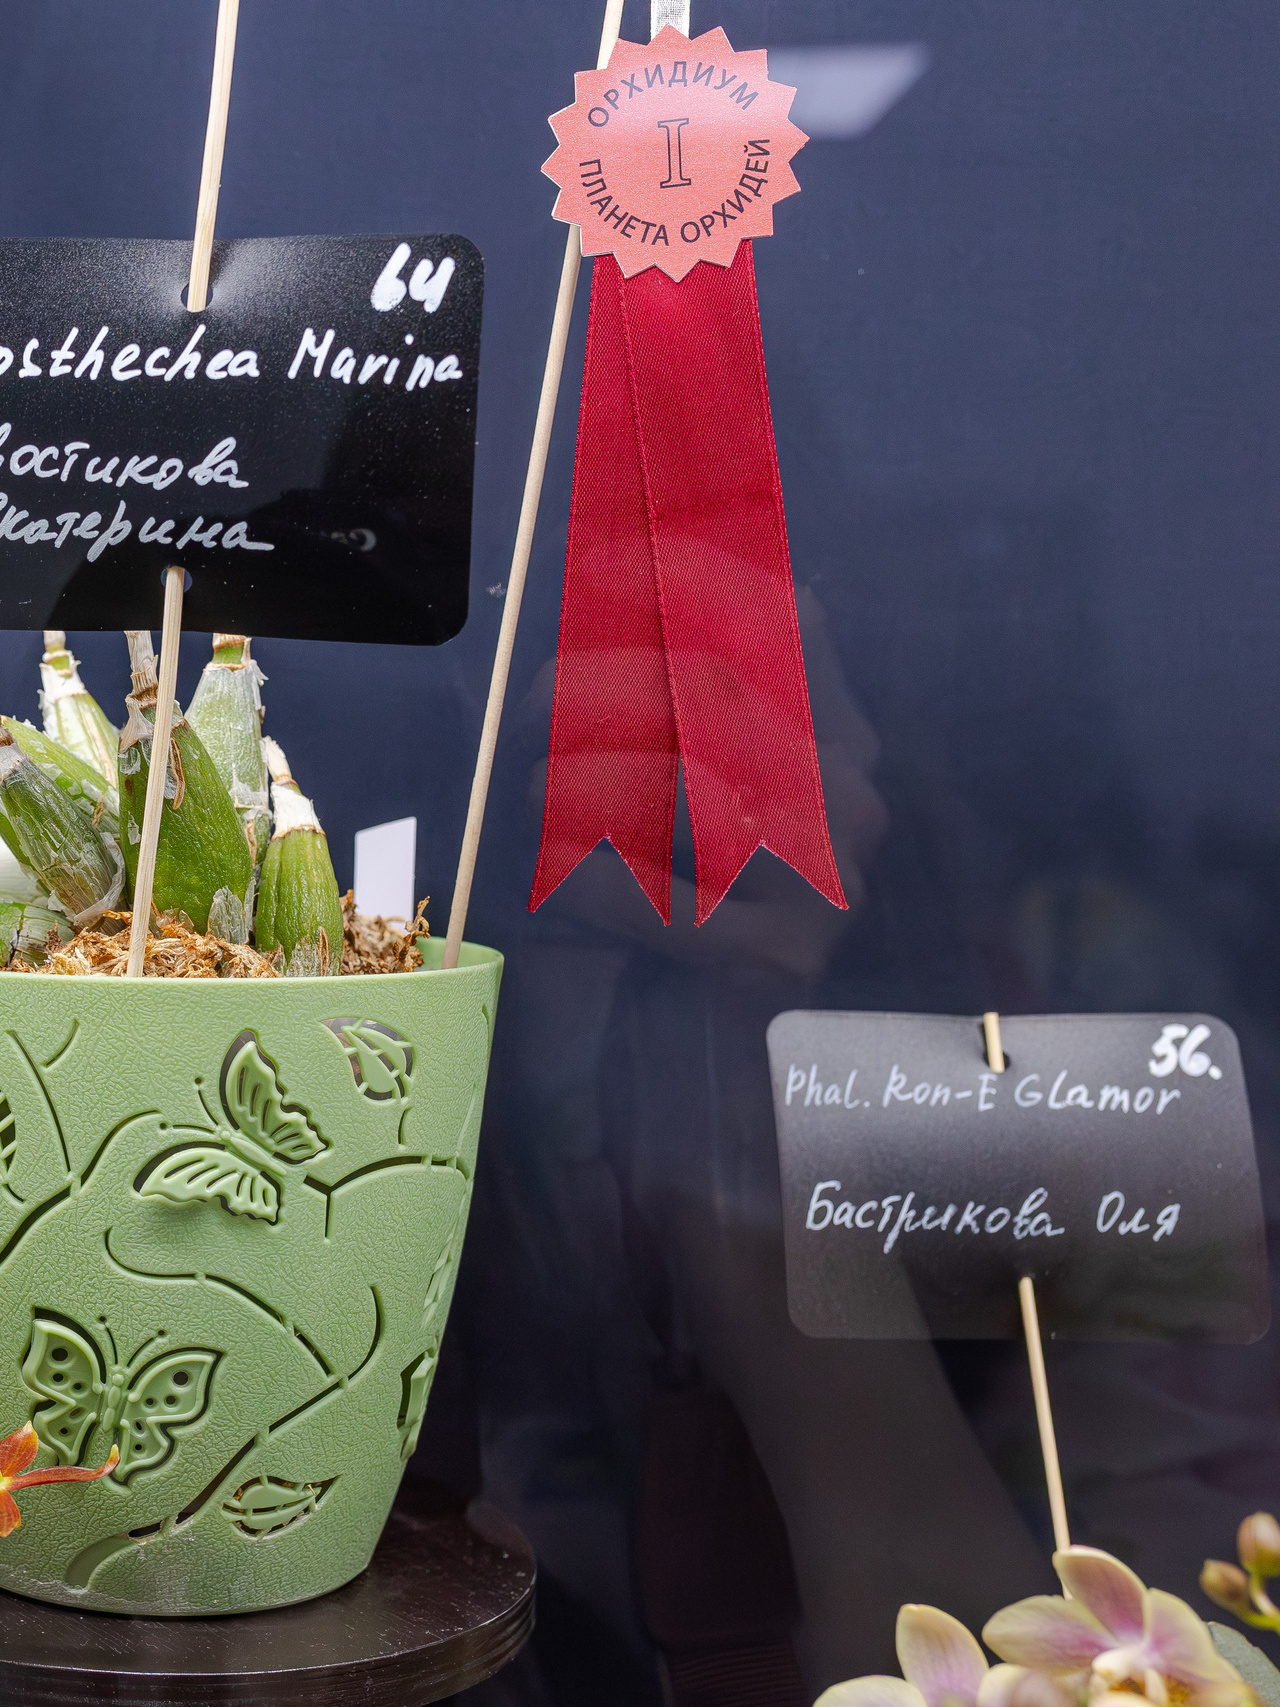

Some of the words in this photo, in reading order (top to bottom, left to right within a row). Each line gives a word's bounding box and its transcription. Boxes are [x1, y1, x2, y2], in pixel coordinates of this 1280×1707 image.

[587, 61, 759, 127] ОРХИДИУМ
[579, 158, 669, 246] ПЛАНЕТА
[680, 139, 770, 243] ОРХИДЕЙ
[370, 242, 456, 313] 64
[287, 327, 463, 391] Marina
[785, 1063, 871, 1109] Phal.
[805, 1179, 1066, 1255] Бастрикова
[1096, 1190, 1182, 1242] Оля
